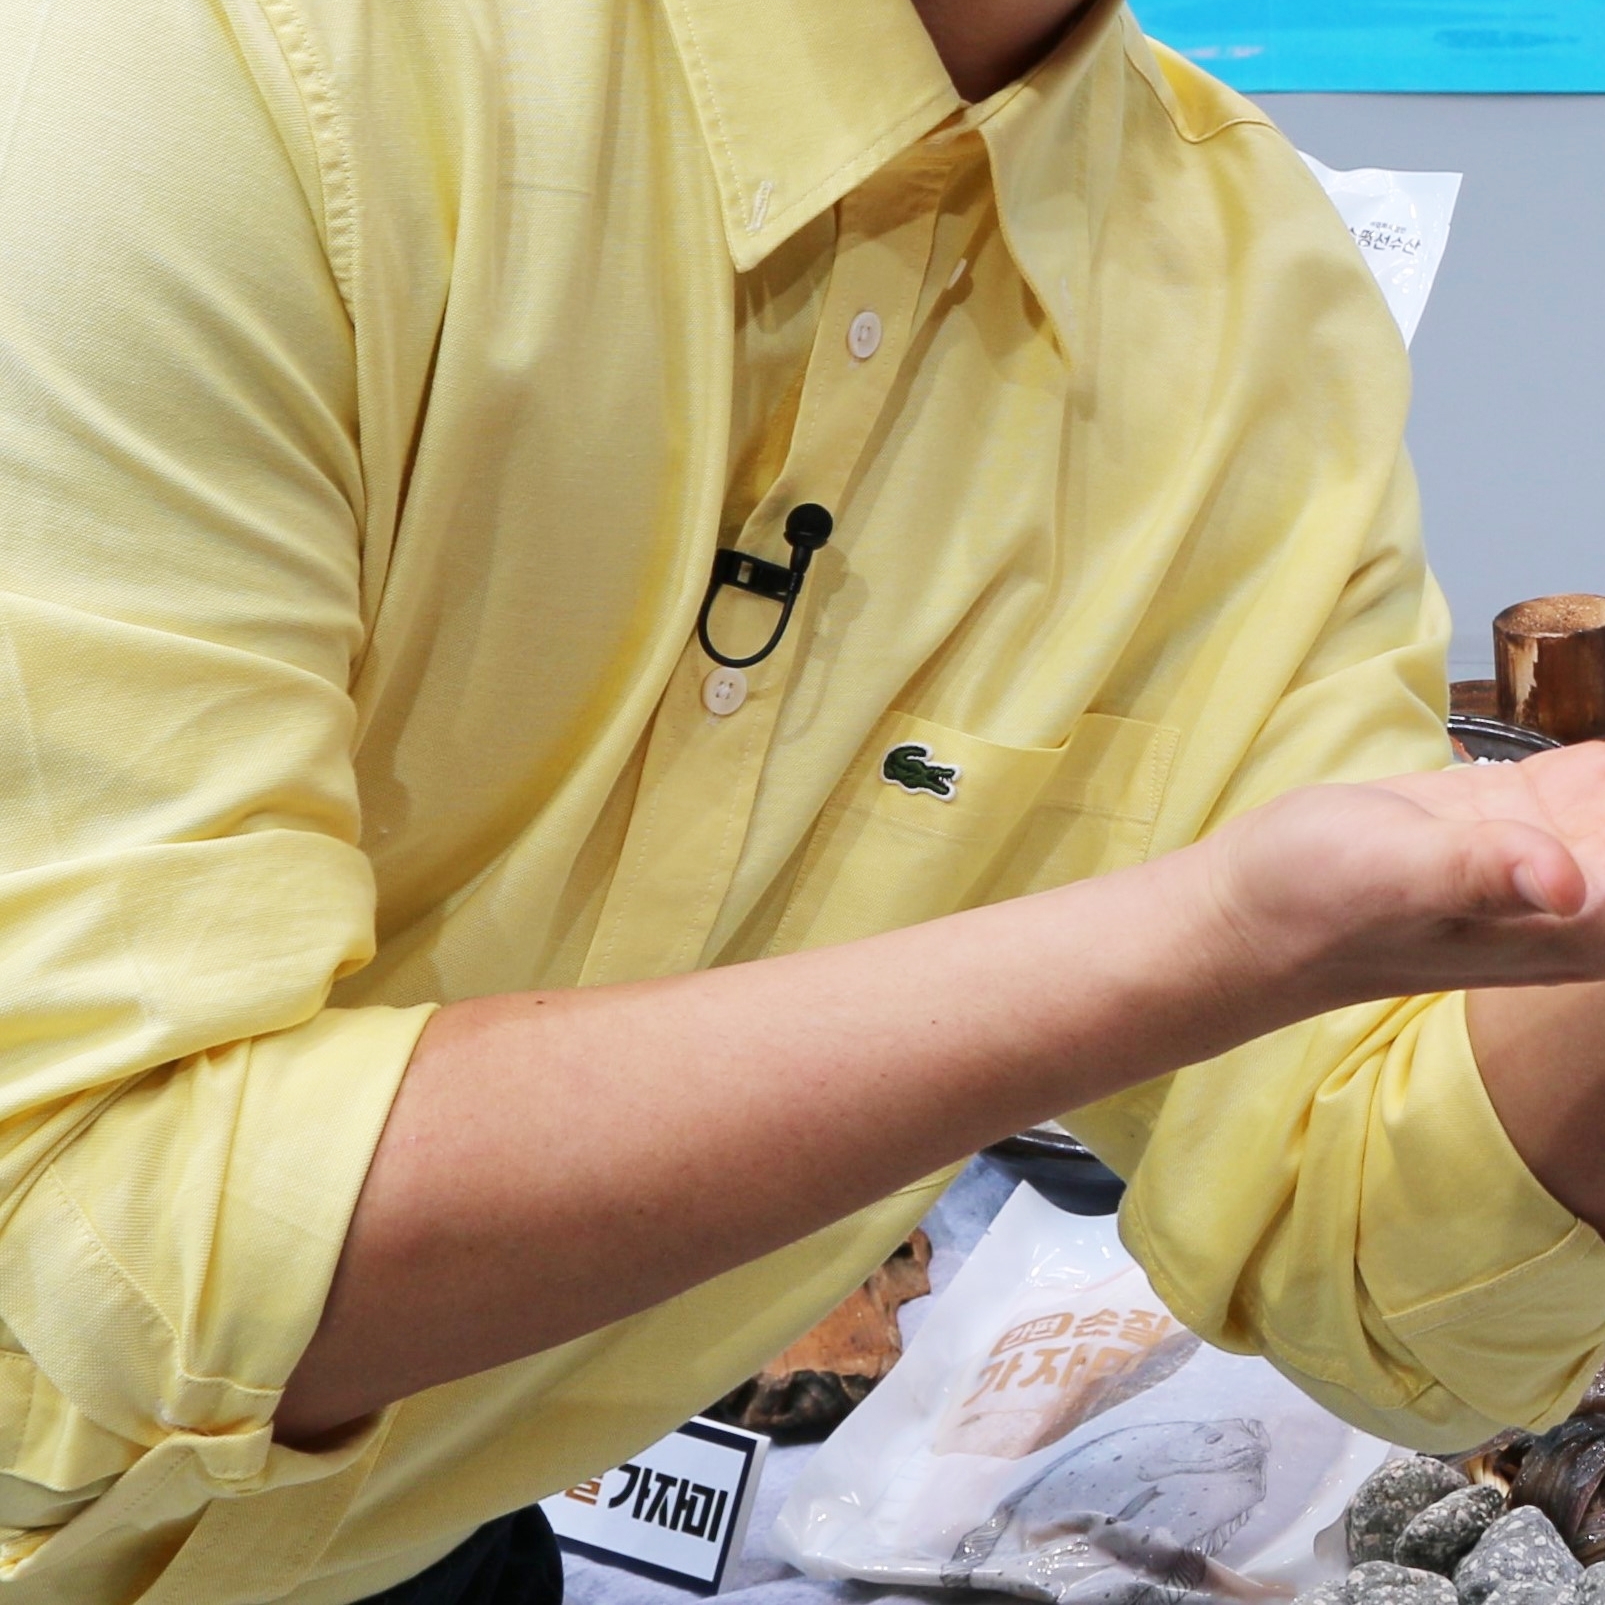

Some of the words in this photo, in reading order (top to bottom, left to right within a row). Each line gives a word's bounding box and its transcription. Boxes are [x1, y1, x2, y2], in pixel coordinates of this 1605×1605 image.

[1350, 227, 1421, 255] 평선수산
[1072, 1308, 1172, 1348] 손질
[608, 1463, 729, 1543] 가자미
